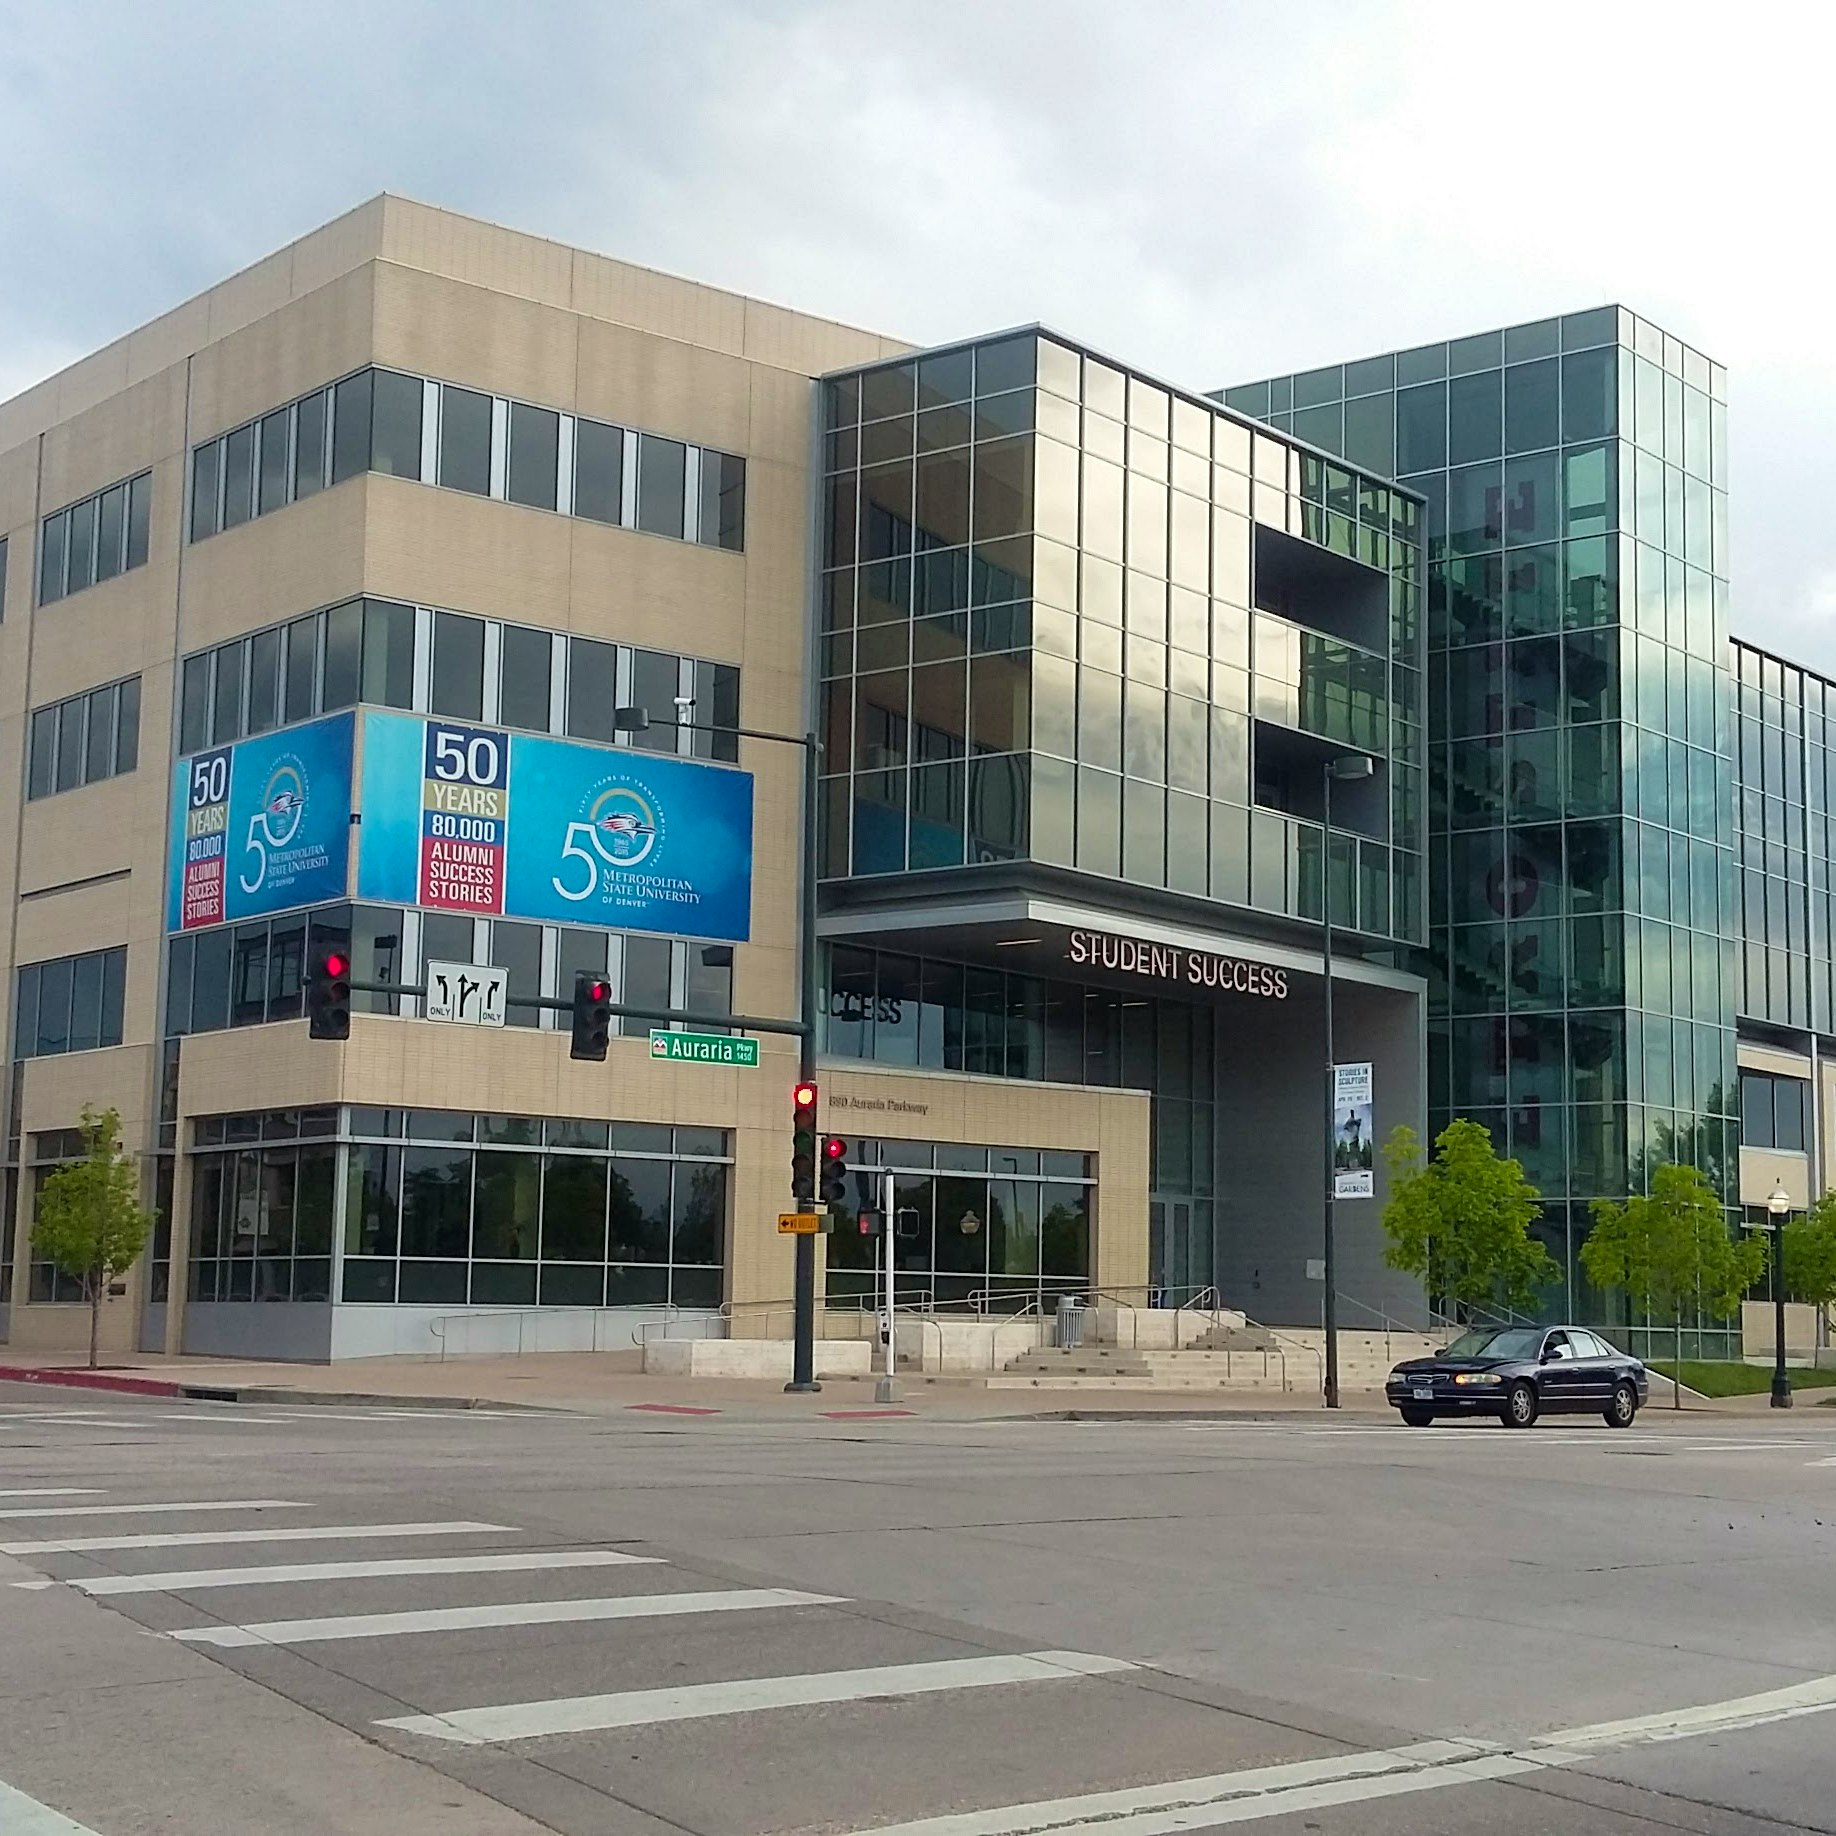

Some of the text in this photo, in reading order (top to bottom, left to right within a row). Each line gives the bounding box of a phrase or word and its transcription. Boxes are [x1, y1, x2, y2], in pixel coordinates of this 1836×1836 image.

[434, 731, 499, 785] 50
[192, 757, 227, 807] 50
[432, 783, 499, 816] YEARS
[190, 807, 225, 835] YEARS
[432, 814, 495, 843] 80,000
[268, 844, 325, 863] METROPOLITAN
[431, 841, 494, 866] ALUMNI
[188, 861, 220, 883] ALUMNI
[268, 855, 329, 877] STATE UNIVERSITY
[429, 861, 494, 885] SUCCESS
[187, 880, 220, 901] SUCCESS
[603, 868, 693, 891] METROPOLITAN
[428, 881, 493, 905] STORIES
[602, 882, 701, 904] STATE UNIVERSITY
[603, 896, 648, 908] OF DENVER
[187, 900, 220, 920] STORIES
[1069, 930, 1288, 999] STUDENT SUCCESS
[430, 1006, 451, 1016] ONLY
[482, 1012, 502, 1021] ONLY
[671, 1038, 753, 1061] Auraria Pkwy
[1338, 1076, 1368, 1085] SCULPTURE
[1362, 1067, 1368, 1075] IN
[850, 1097, 885, 1110] Auraria
[887, 1099, 928, 1116] Parkway
[1338, 1185, 1370, 1193] GARDENS
